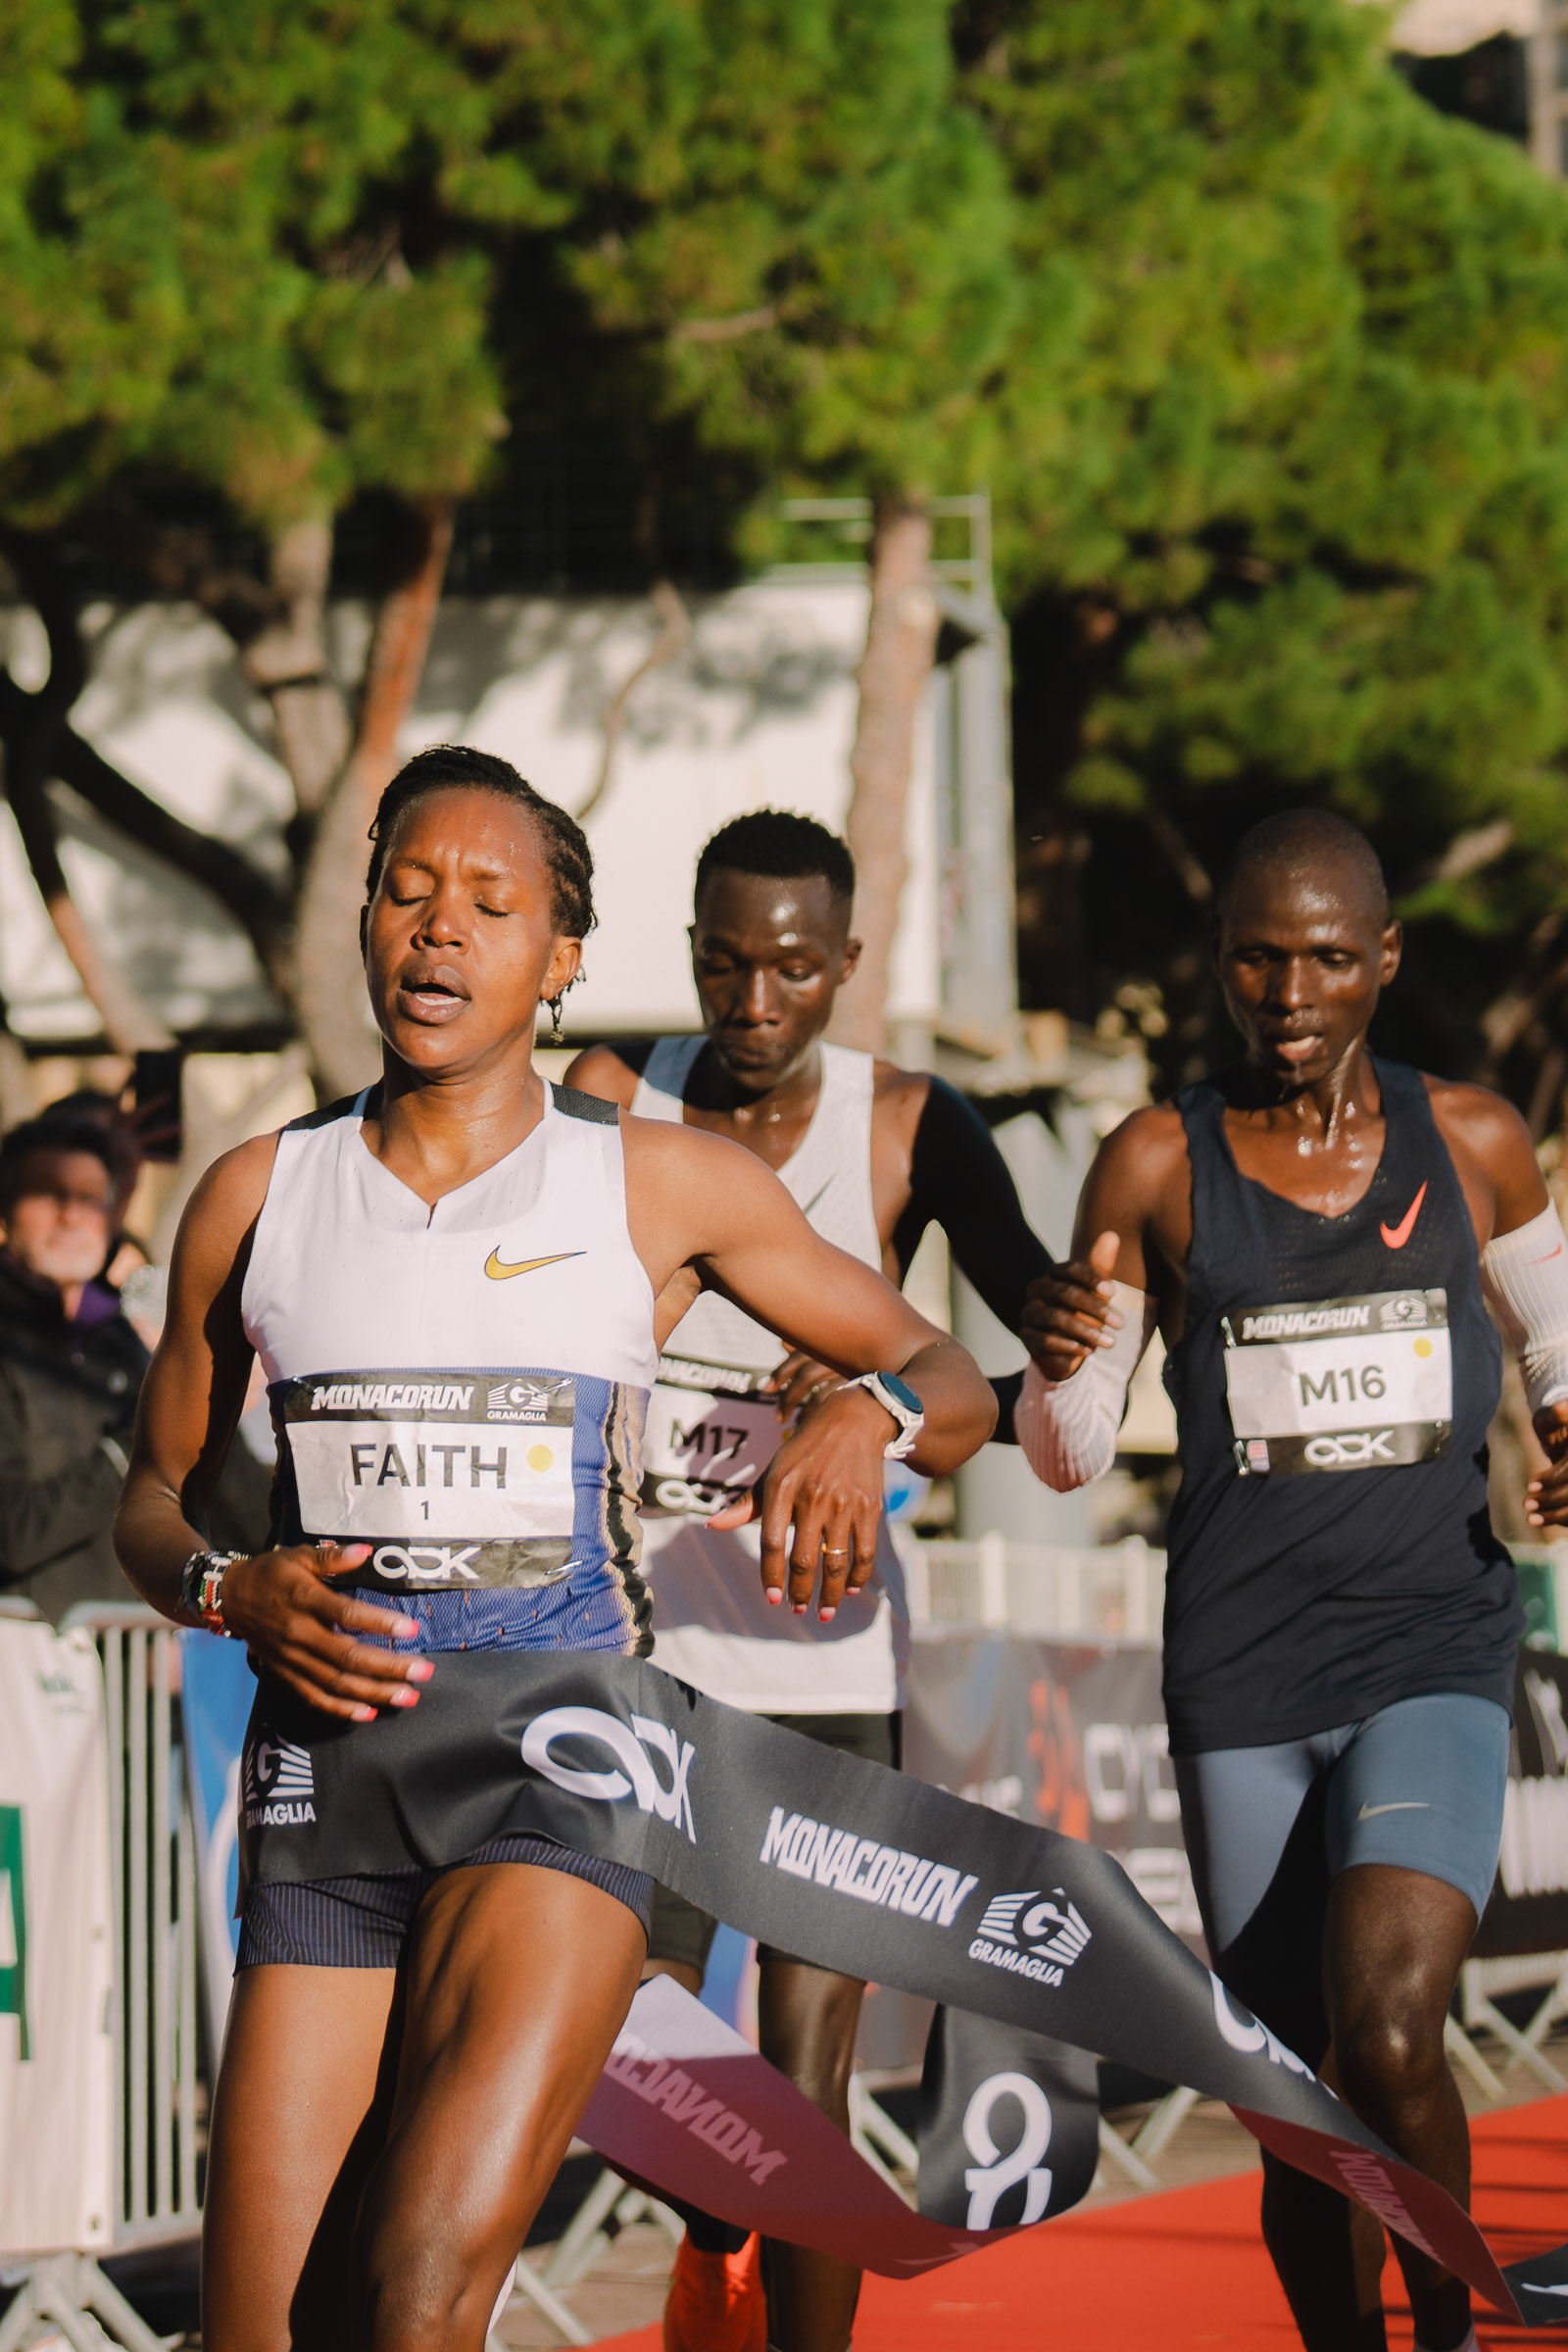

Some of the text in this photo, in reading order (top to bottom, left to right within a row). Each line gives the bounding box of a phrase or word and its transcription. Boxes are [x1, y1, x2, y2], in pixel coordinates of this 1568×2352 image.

[1242, 1304, 1372, 1341] MONACORUN
[310, 1384, 475, 1411] MONACORUN
[1298, 1364, 1388, 1406] M16
[486, 1409, 547, 1422] GRAMAGLIA
[669, 1418, 750, 1458] M17
[350, 1443, 508, 1490] FAITH
[420, 1500, 430, 1521] 1
[760, 1805, 980, 1929] MONACORUN
[967, 1937, 1065, 1987] GRAMAGLIA
